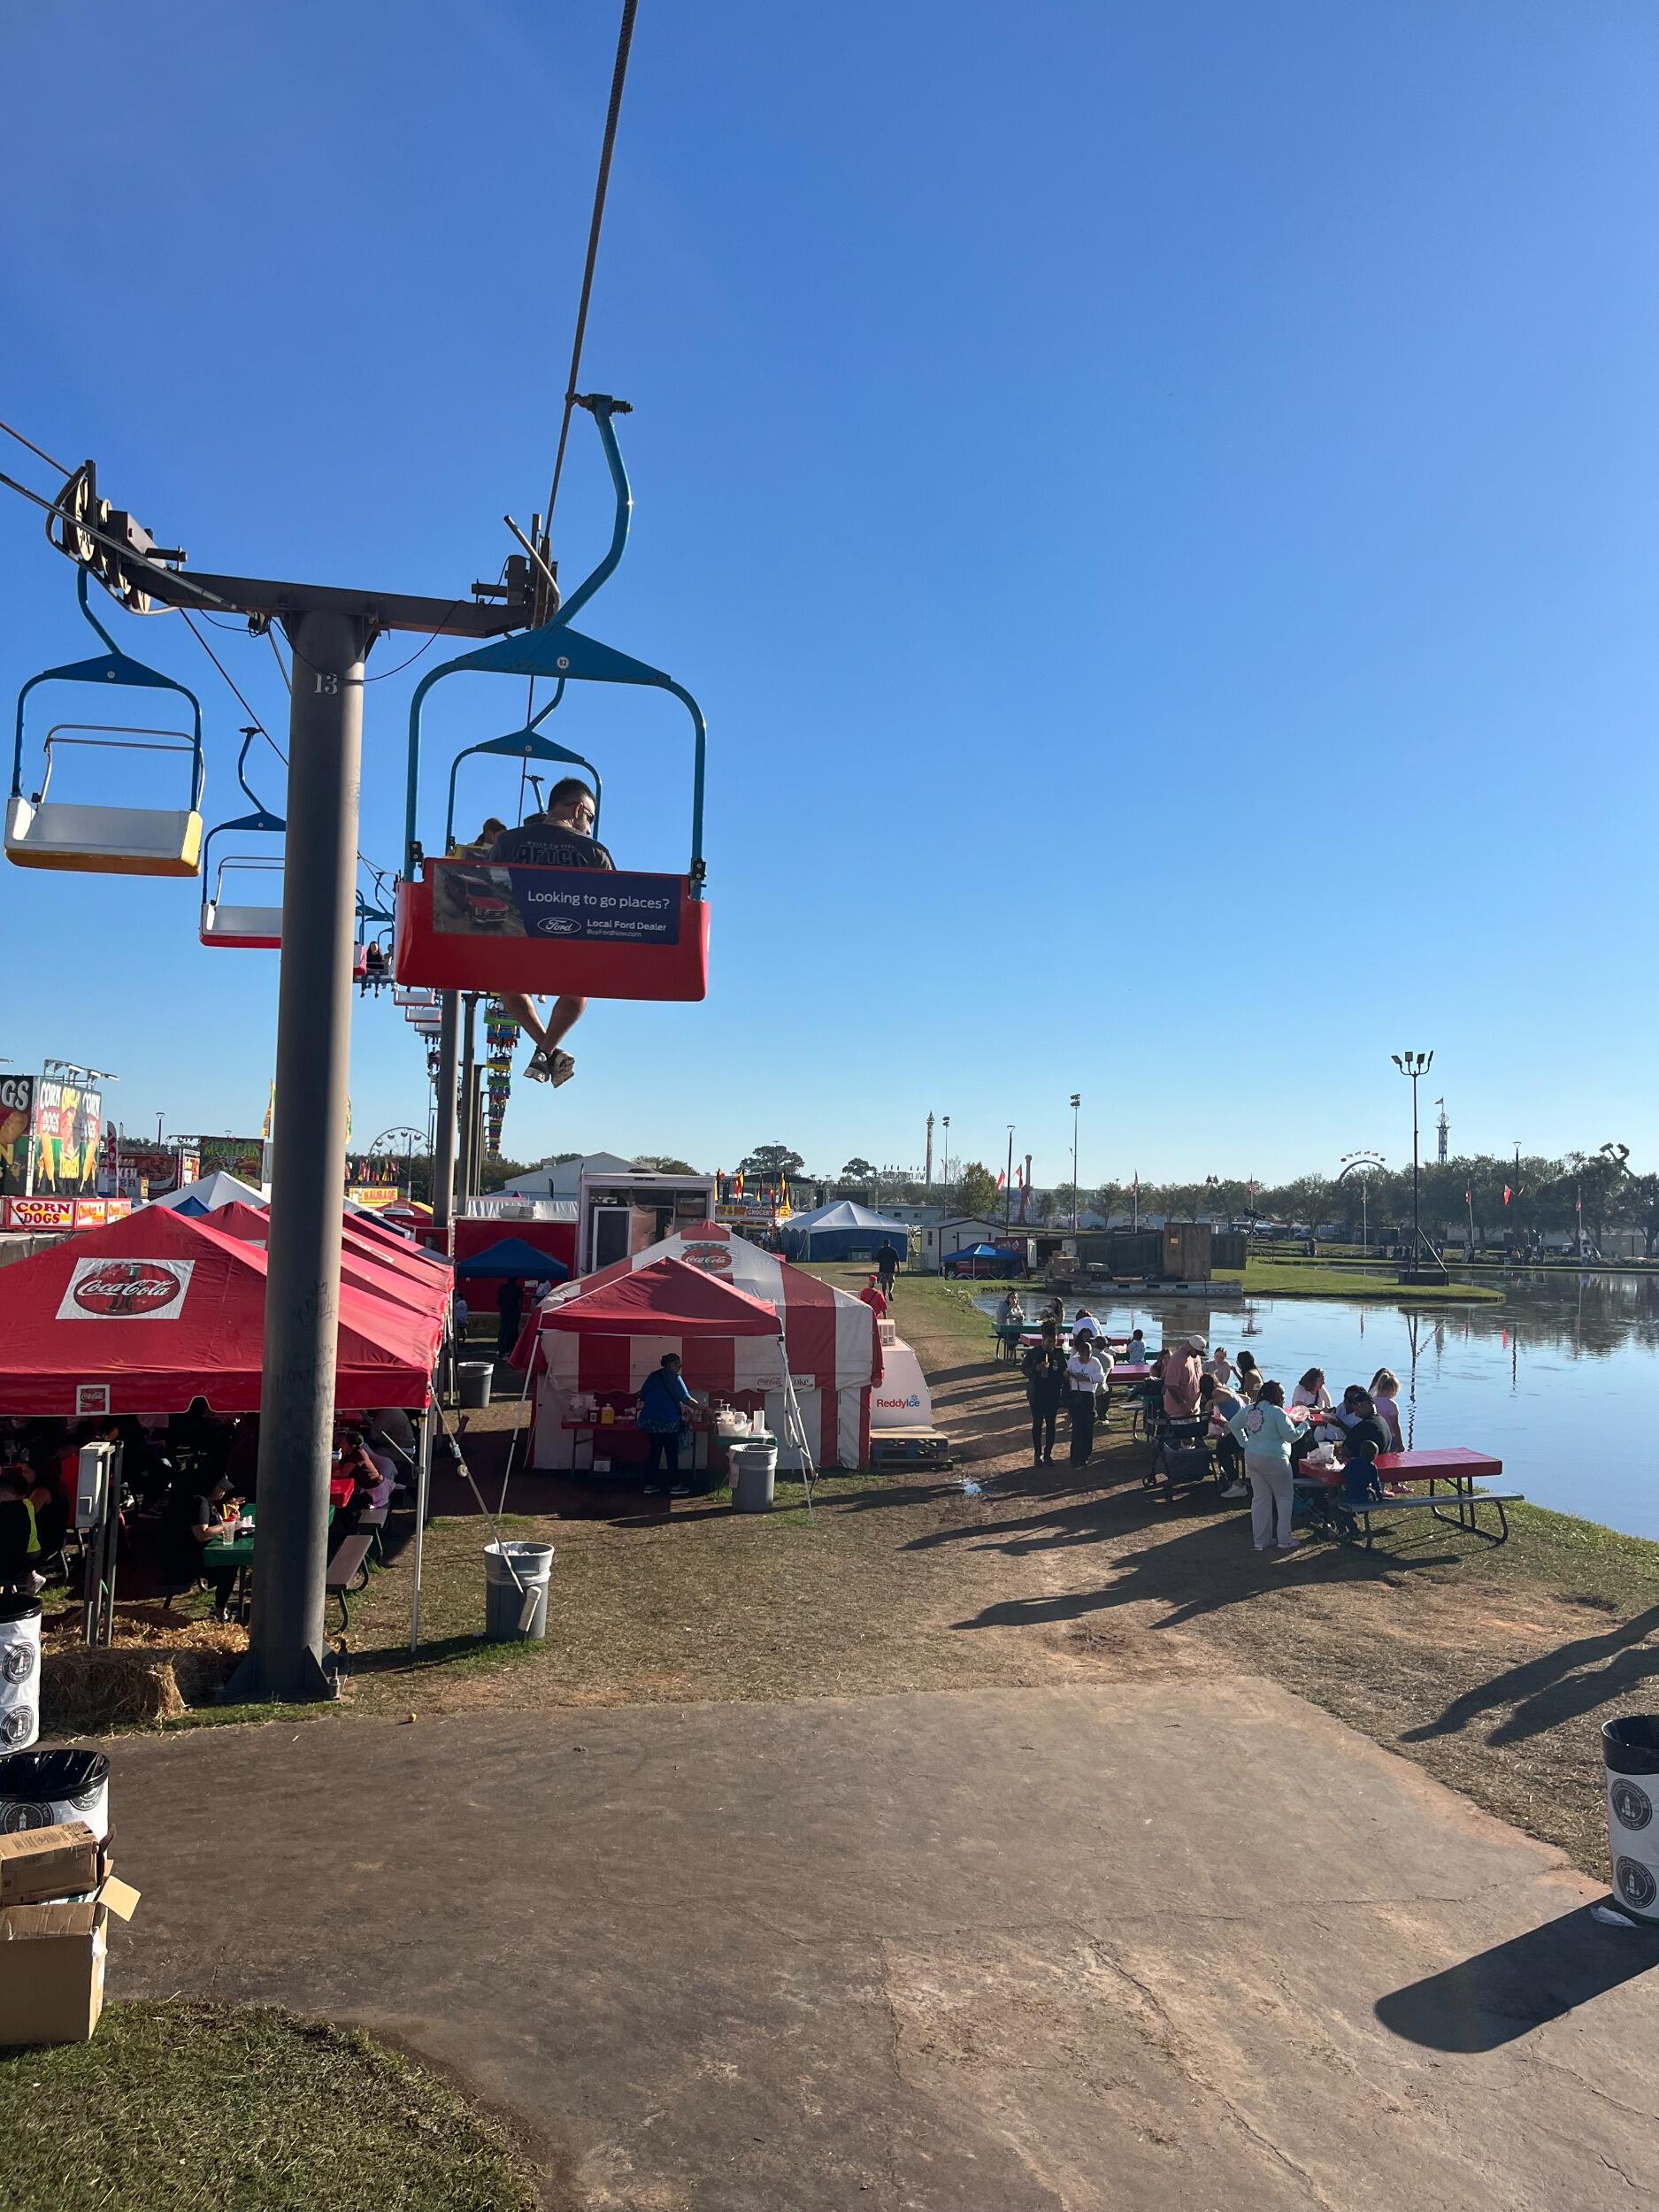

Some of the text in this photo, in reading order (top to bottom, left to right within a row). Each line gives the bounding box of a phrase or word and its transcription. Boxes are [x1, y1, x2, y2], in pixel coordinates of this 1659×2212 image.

[312, 672, 338, 694] 13
[527, 890, 670, 910] Looking to go places?
[546, 919, 573, 932] Ford
[587, 919, 667, 932] Local Ford Dealer
[0, 1079, 29, 1111] GS
[40, 1081, 62, 1110] CORN
[82, 1091, 101, 1120] CORN
[42, 1110, 60, 1133] DOGS
[364, 1190, 396, 1201] SAUSAGE
[16, 1202, 71, 1214] CORN
[24, 1213, 60, 1224] DOGS
